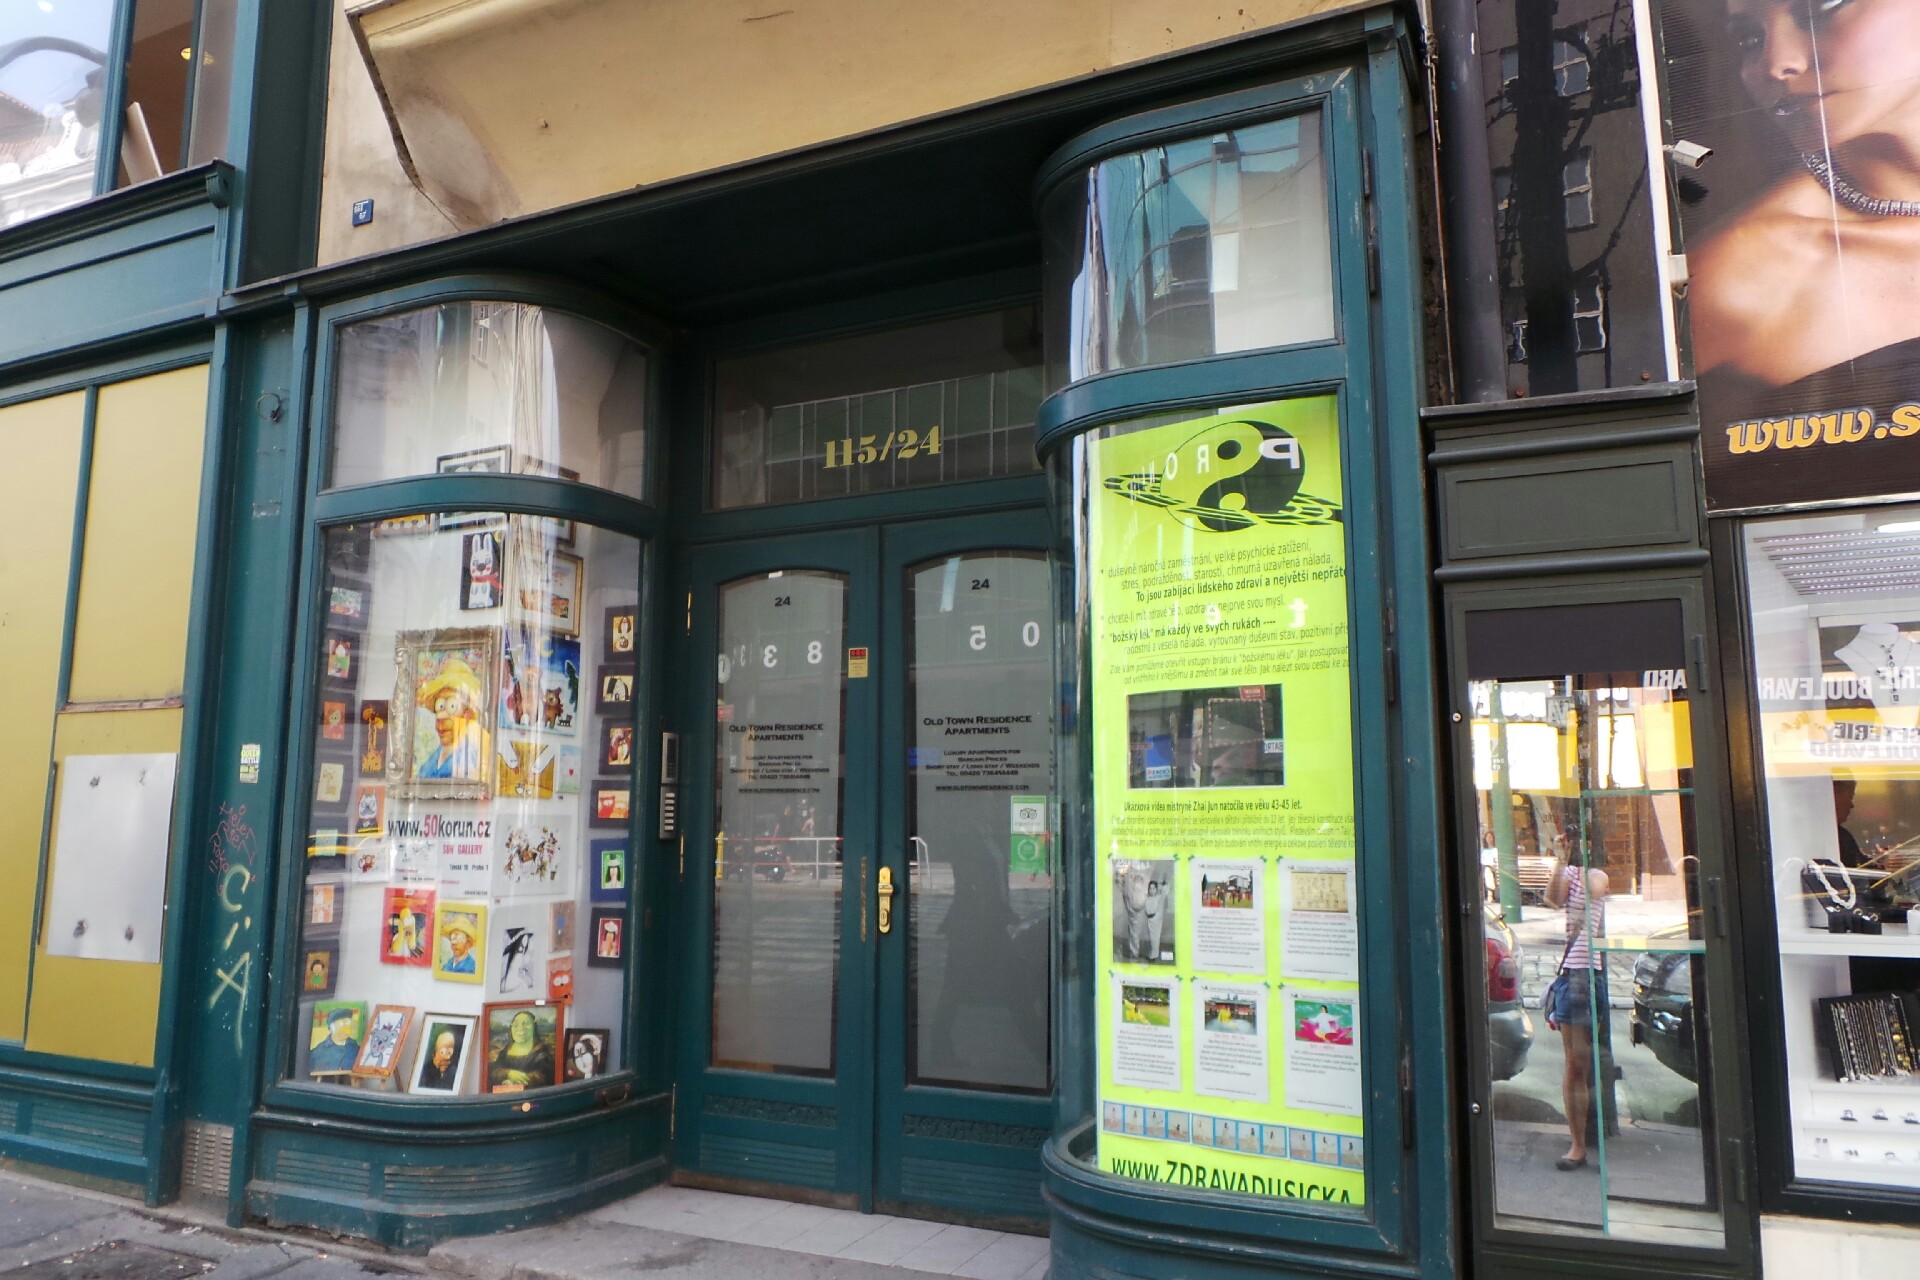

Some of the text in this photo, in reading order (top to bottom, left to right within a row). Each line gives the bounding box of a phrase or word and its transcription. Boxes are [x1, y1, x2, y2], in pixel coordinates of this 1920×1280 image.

[823, 425, 943, 469] 115/24
[971, 578, 990, 590] 24
[1136, 591, 1145, 602] To
[1147, 590, 1162, 603] jsou
[1236, 576, 1263, 590] zdraví
[1265, 578, 1271, 587] a
[1273, 573, 1310, 588] největší
[774, 596, 791, 607] 24
[1194, 624, 1204, 634] ve
[1232, 617, 1261, 631] rukách
[924, 715, 1032, 726] OLD TOWN RESIDENCE
[729, 723, 823, 732] OLD TOWN RESIDENCE
[945, 727, 1010, 736] APARTMENTS
[748, 733, 804, 741] APARTMENTS
[1271, 799, 1290, 810] 43-45
[388, 814, 491, 838] www.50korun.cz
